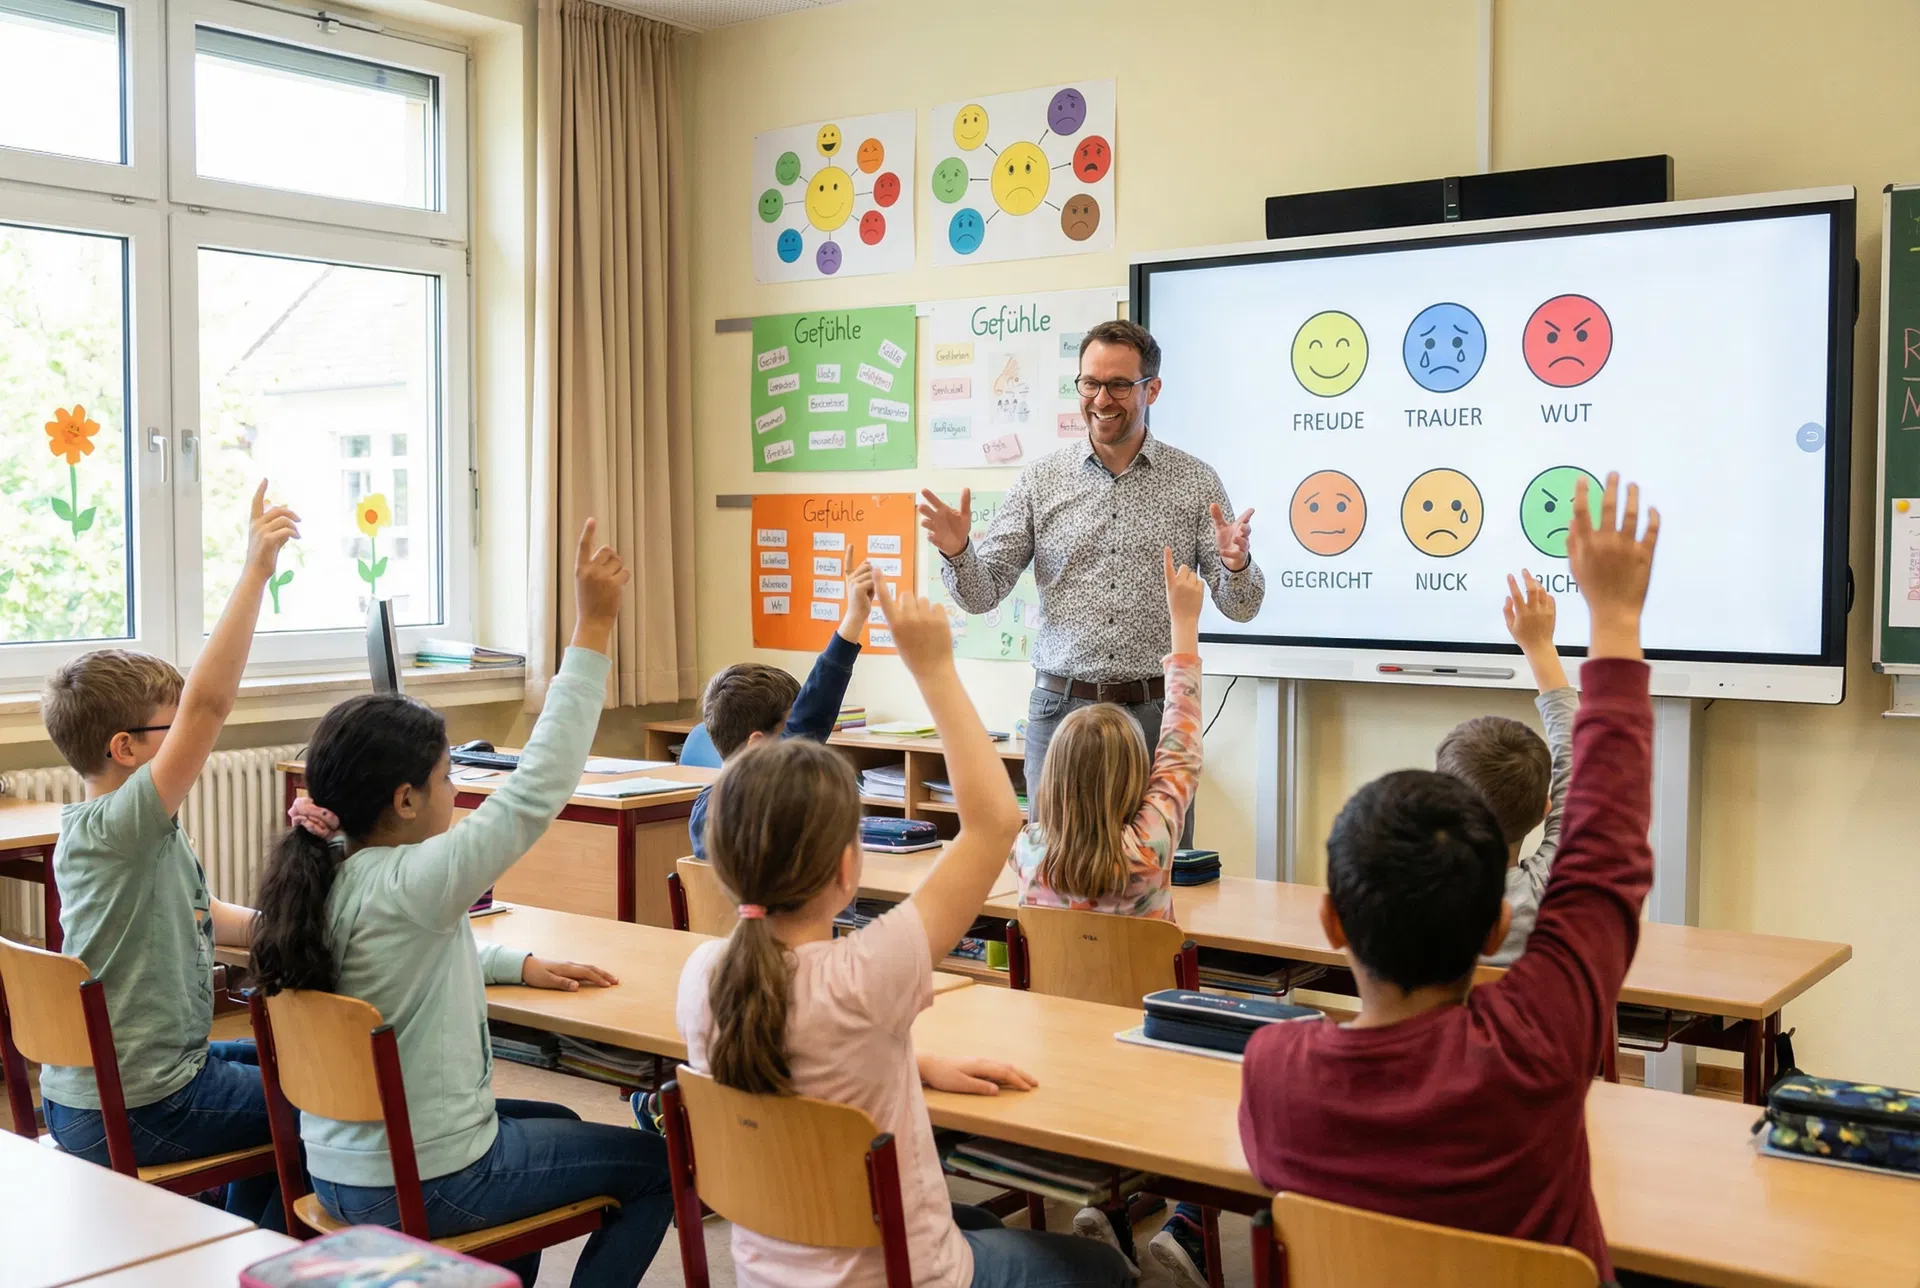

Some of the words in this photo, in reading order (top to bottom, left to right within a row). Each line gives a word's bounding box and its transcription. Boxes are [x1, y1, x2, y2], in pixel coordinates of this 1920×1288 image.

[794, 314, 862, 348] Gefühle
[971, 303, 1051, 342] Gefühle
[1293, 411, 1365, 431] FREUDE
[1404, 407, 1483, 428] TRAUER
[1540, 402, 1593, 423] WUT
[803, 499, 864, 529] Gefühle
[1280, 570, 1373, 589] GEGRICHT
[1415, 572, 1468, 591] NUCK
